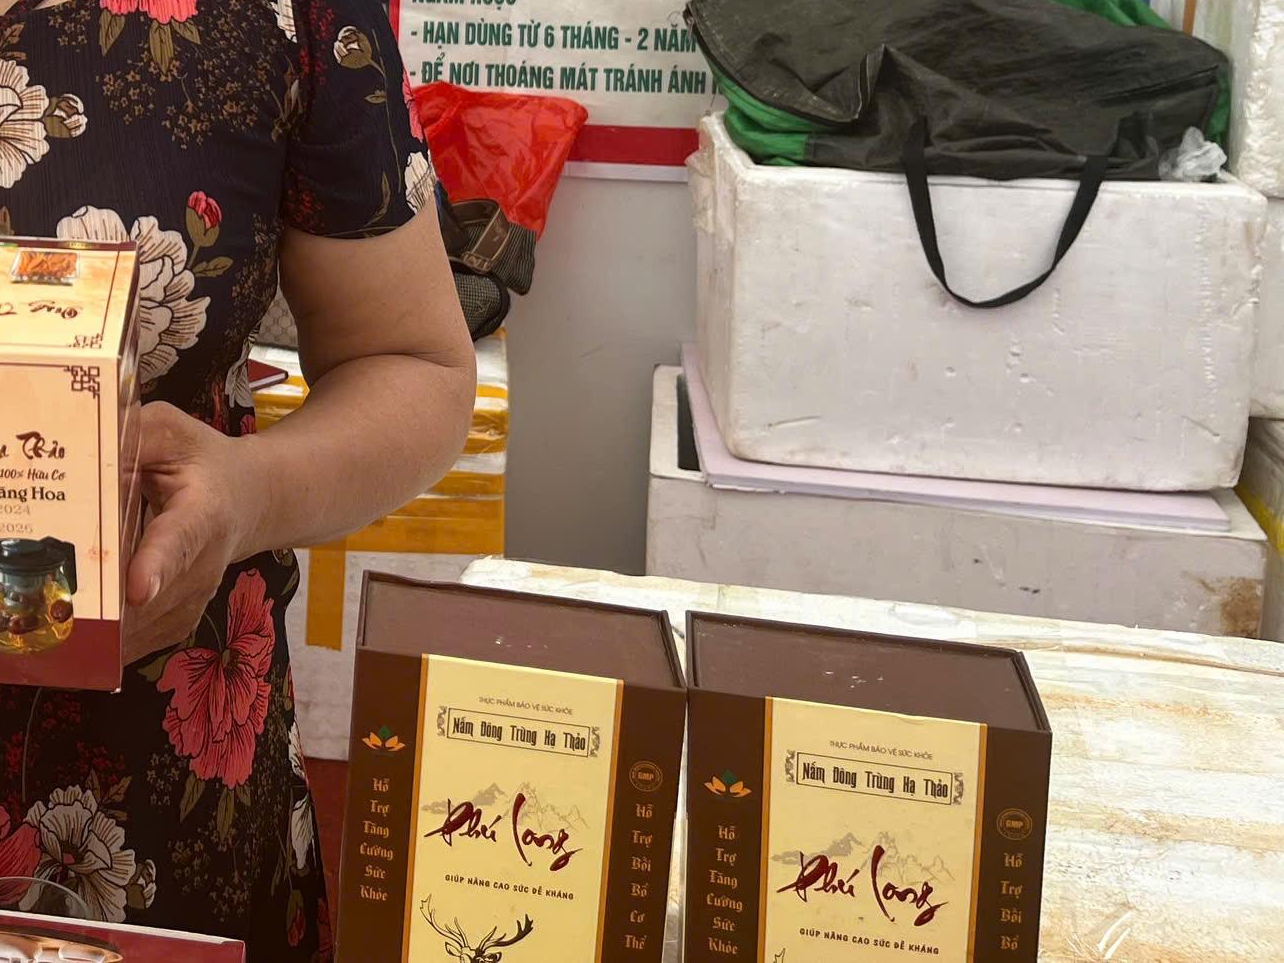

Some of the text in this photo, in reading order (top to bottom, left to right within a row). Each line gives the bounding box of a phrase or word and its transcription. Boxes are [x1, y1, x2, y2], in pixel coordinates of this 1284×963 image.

[423, 21, 460, 48] HẠN
[465, 20, 512, 47] DÙNG
[518, 20, 540, 48] TỪ
[544, 28, 555, 48] 6
[560, 24, 619, 49] THÁNG
[637, 30, 649, 50] 2
[449, 62, 480, 86] NƠI
[486, 61, 554, 89] THOÁNG
[560, 64, 598, 91] MÁT
[603, 63, 662, 92] TRÁNH
[667, 63, 706, 94] ÁNH
[32, 486, 66, 501] Hoa
